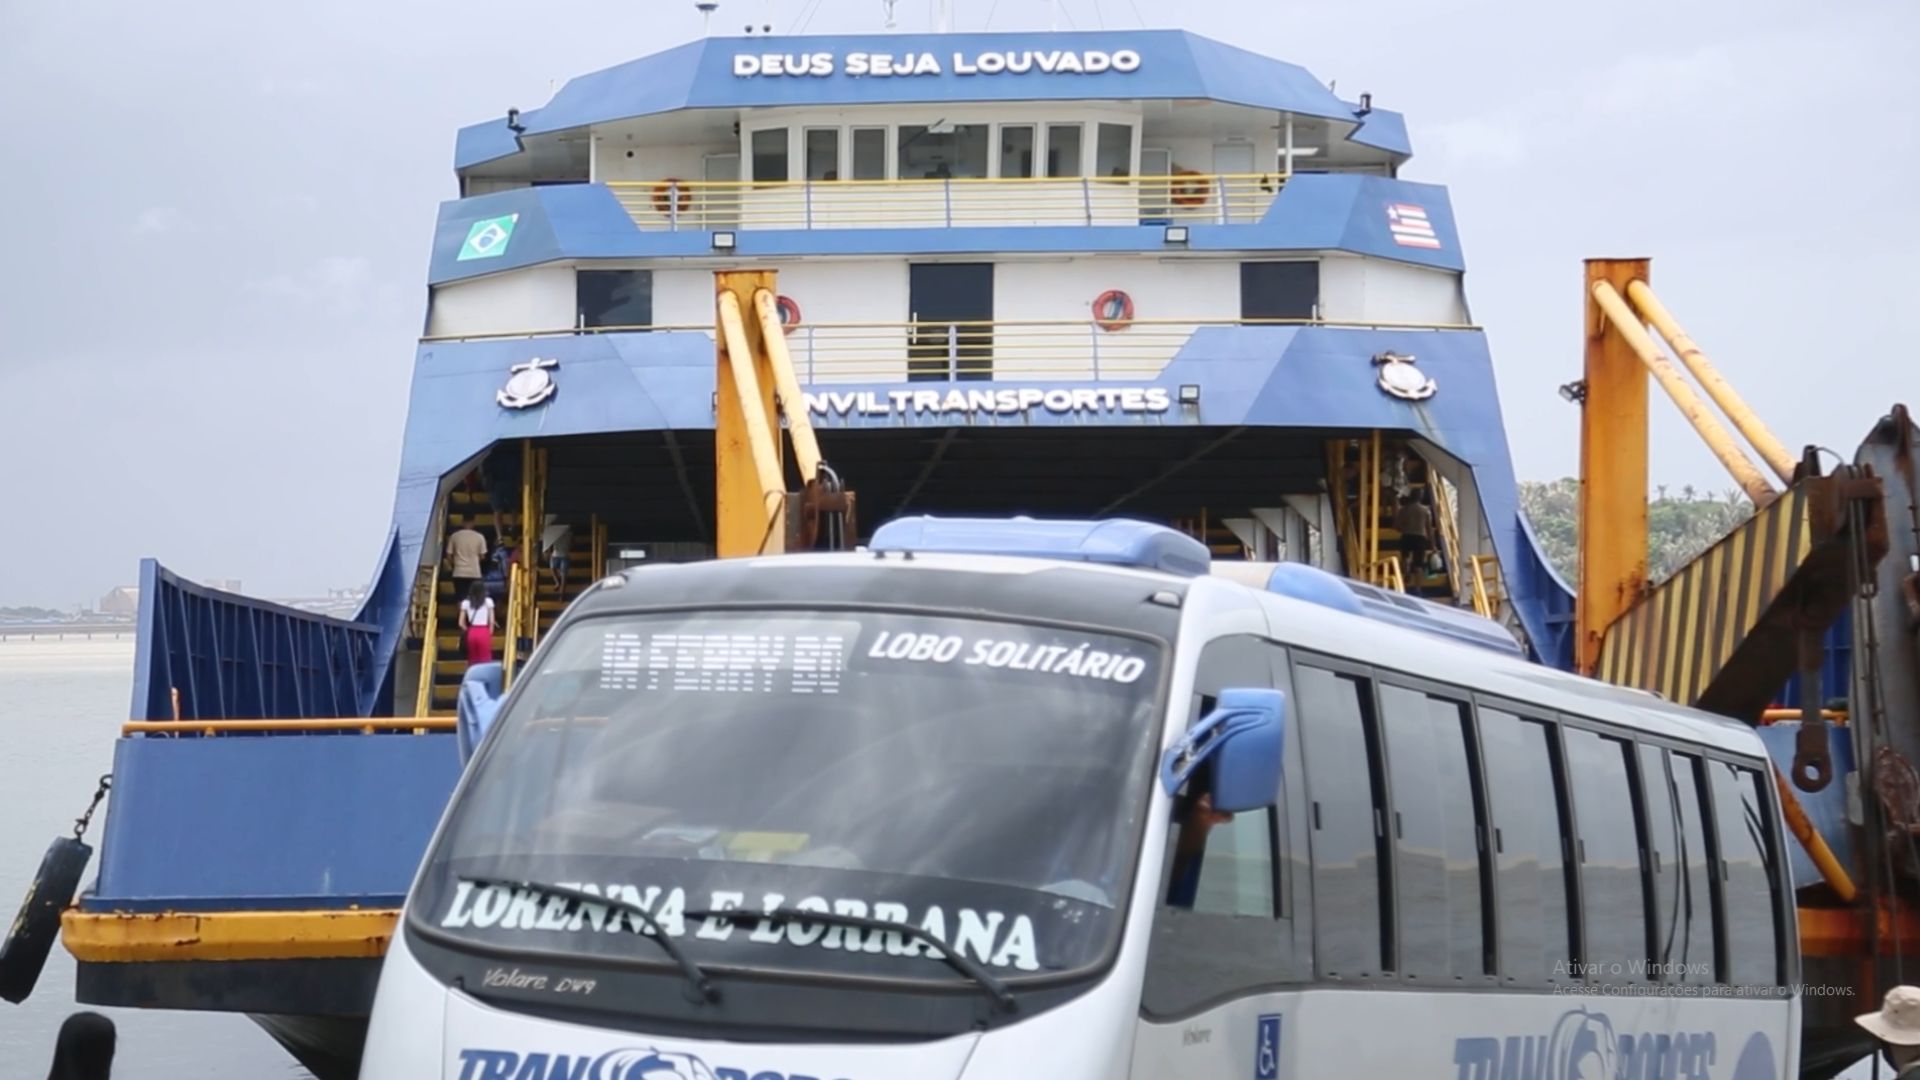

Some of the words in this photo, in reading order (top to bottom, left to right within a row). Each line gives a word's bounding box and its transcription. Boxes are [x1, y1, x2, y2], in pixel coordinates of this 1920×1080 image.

[733, 53, 833, 77] DEUS
[844, 52, 940, 76] SEJA
[953, 49, 1141, 74] LOUVADO
[647, 634, 785, 692] FERRY
[867, 631, 963, 663] LOBO
[963, 641, 1147, 684] SOLITÁRIO
[441, 881, 685, 937] LORENNA
[696, 891, 744, 941] E
[750, 892, 1040, 971] LORRANA
[482, 968, 548, 990] Volare
